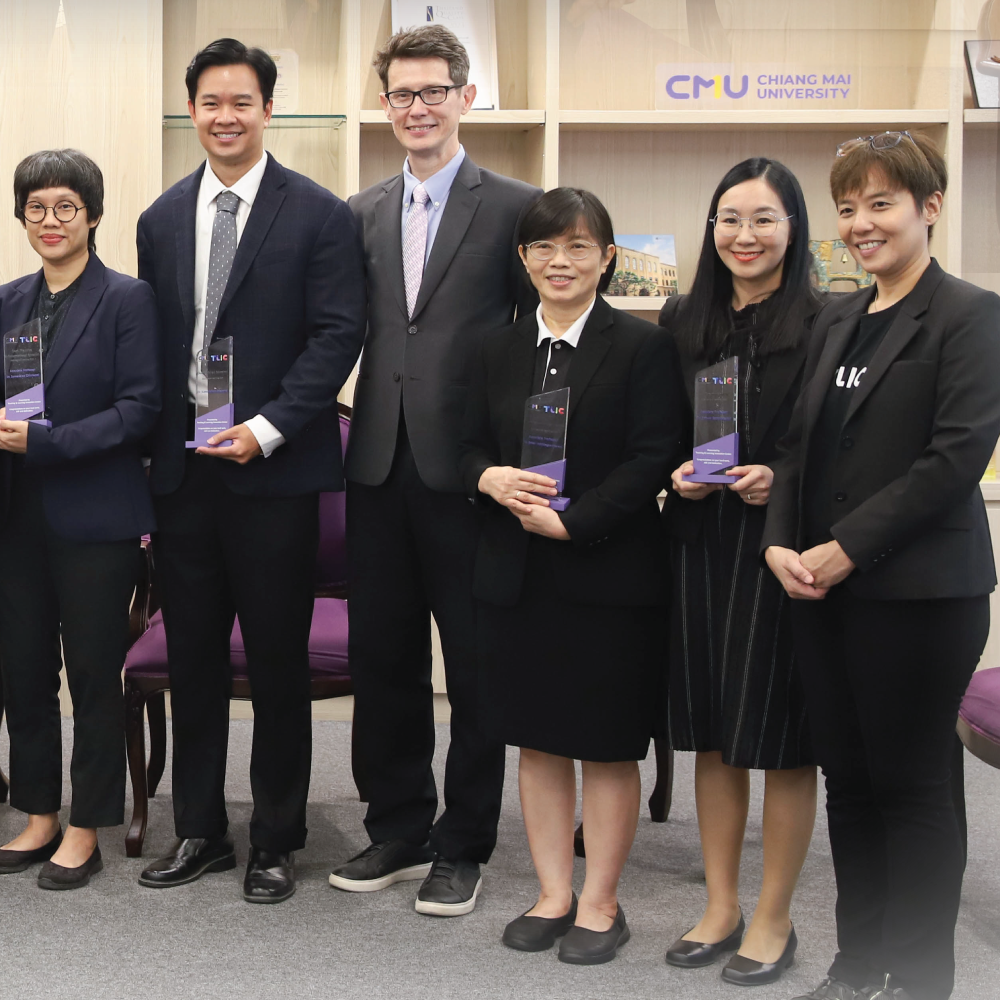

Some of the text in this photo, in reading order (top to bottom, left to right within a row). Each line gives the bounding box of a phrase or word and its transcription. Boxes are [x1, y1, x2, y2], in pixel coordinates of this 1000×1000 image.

[757, 74, 851, 85] CHIANG MAI
[666, 75, 748, 99] CMU
[757, 88, 850, 99] UNIVERSITY
[835, 366, 867, 388] LIC
[543, 406, 565, 414] TLIC
